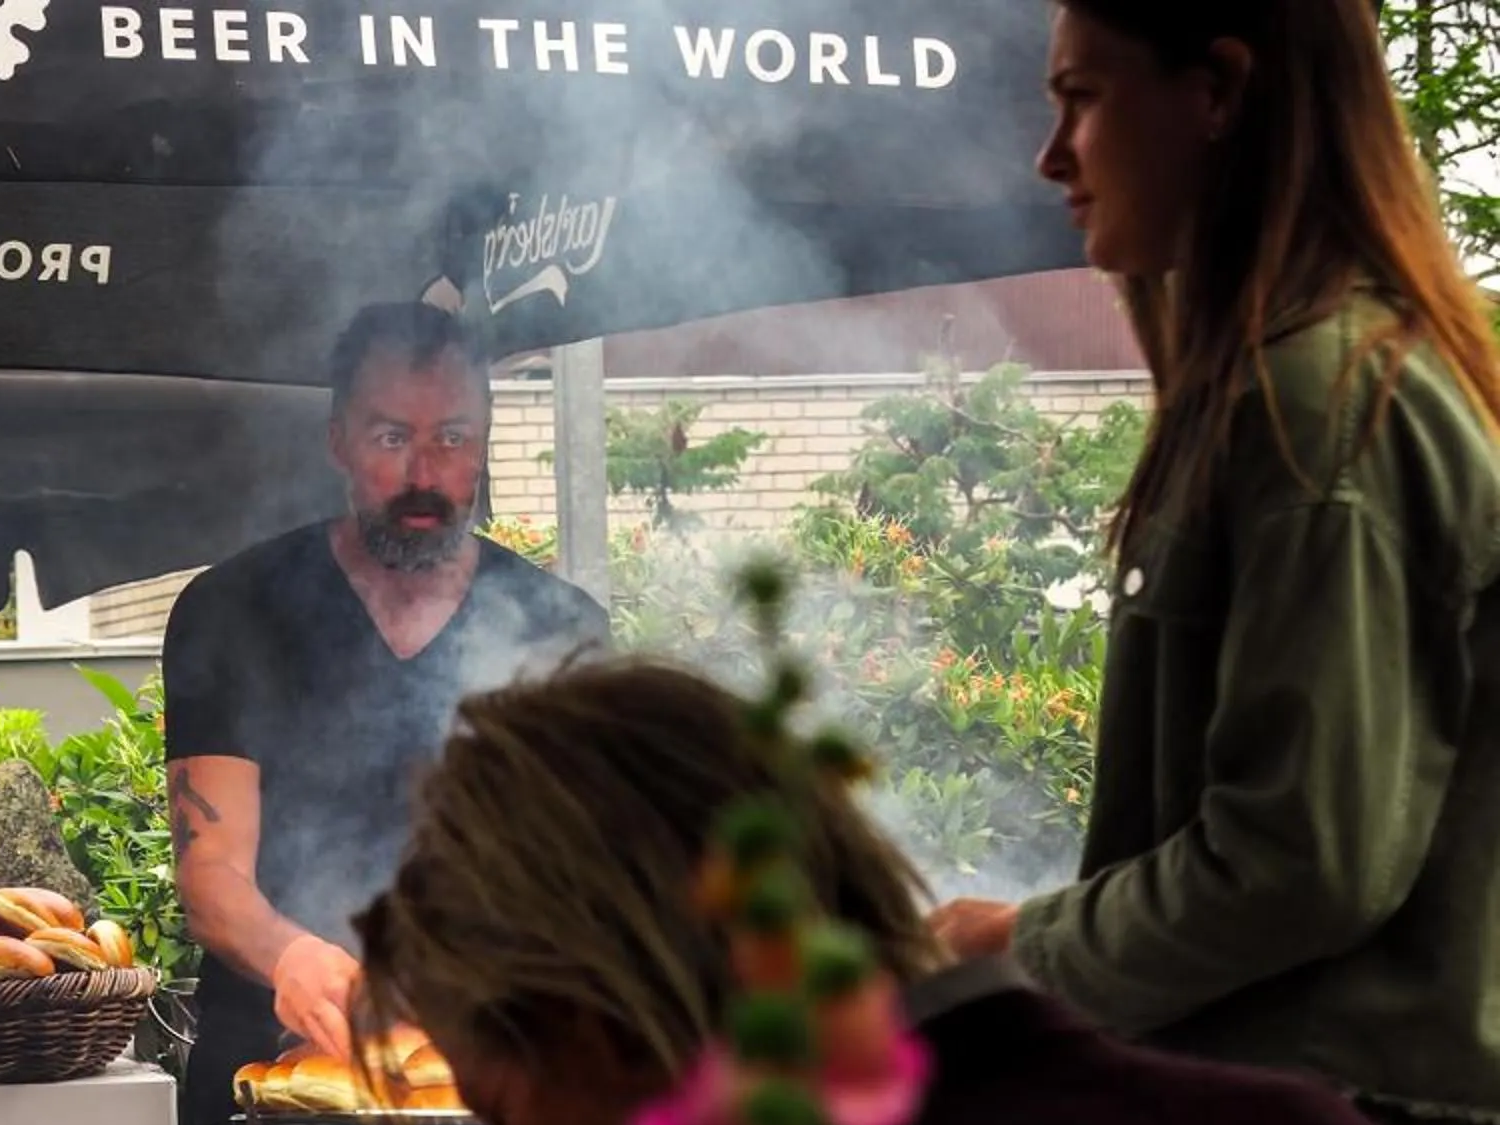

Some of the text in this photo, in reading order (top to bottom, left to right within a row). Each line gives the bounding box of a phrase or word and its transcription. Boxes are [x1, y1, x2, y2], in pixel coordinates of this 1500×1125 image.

[101, 6, 311, 64] BEER
[359, 14, 437, 67] IN
[478, 18, 629, 75] THE
[672, 24, 957, 89] WORLD
